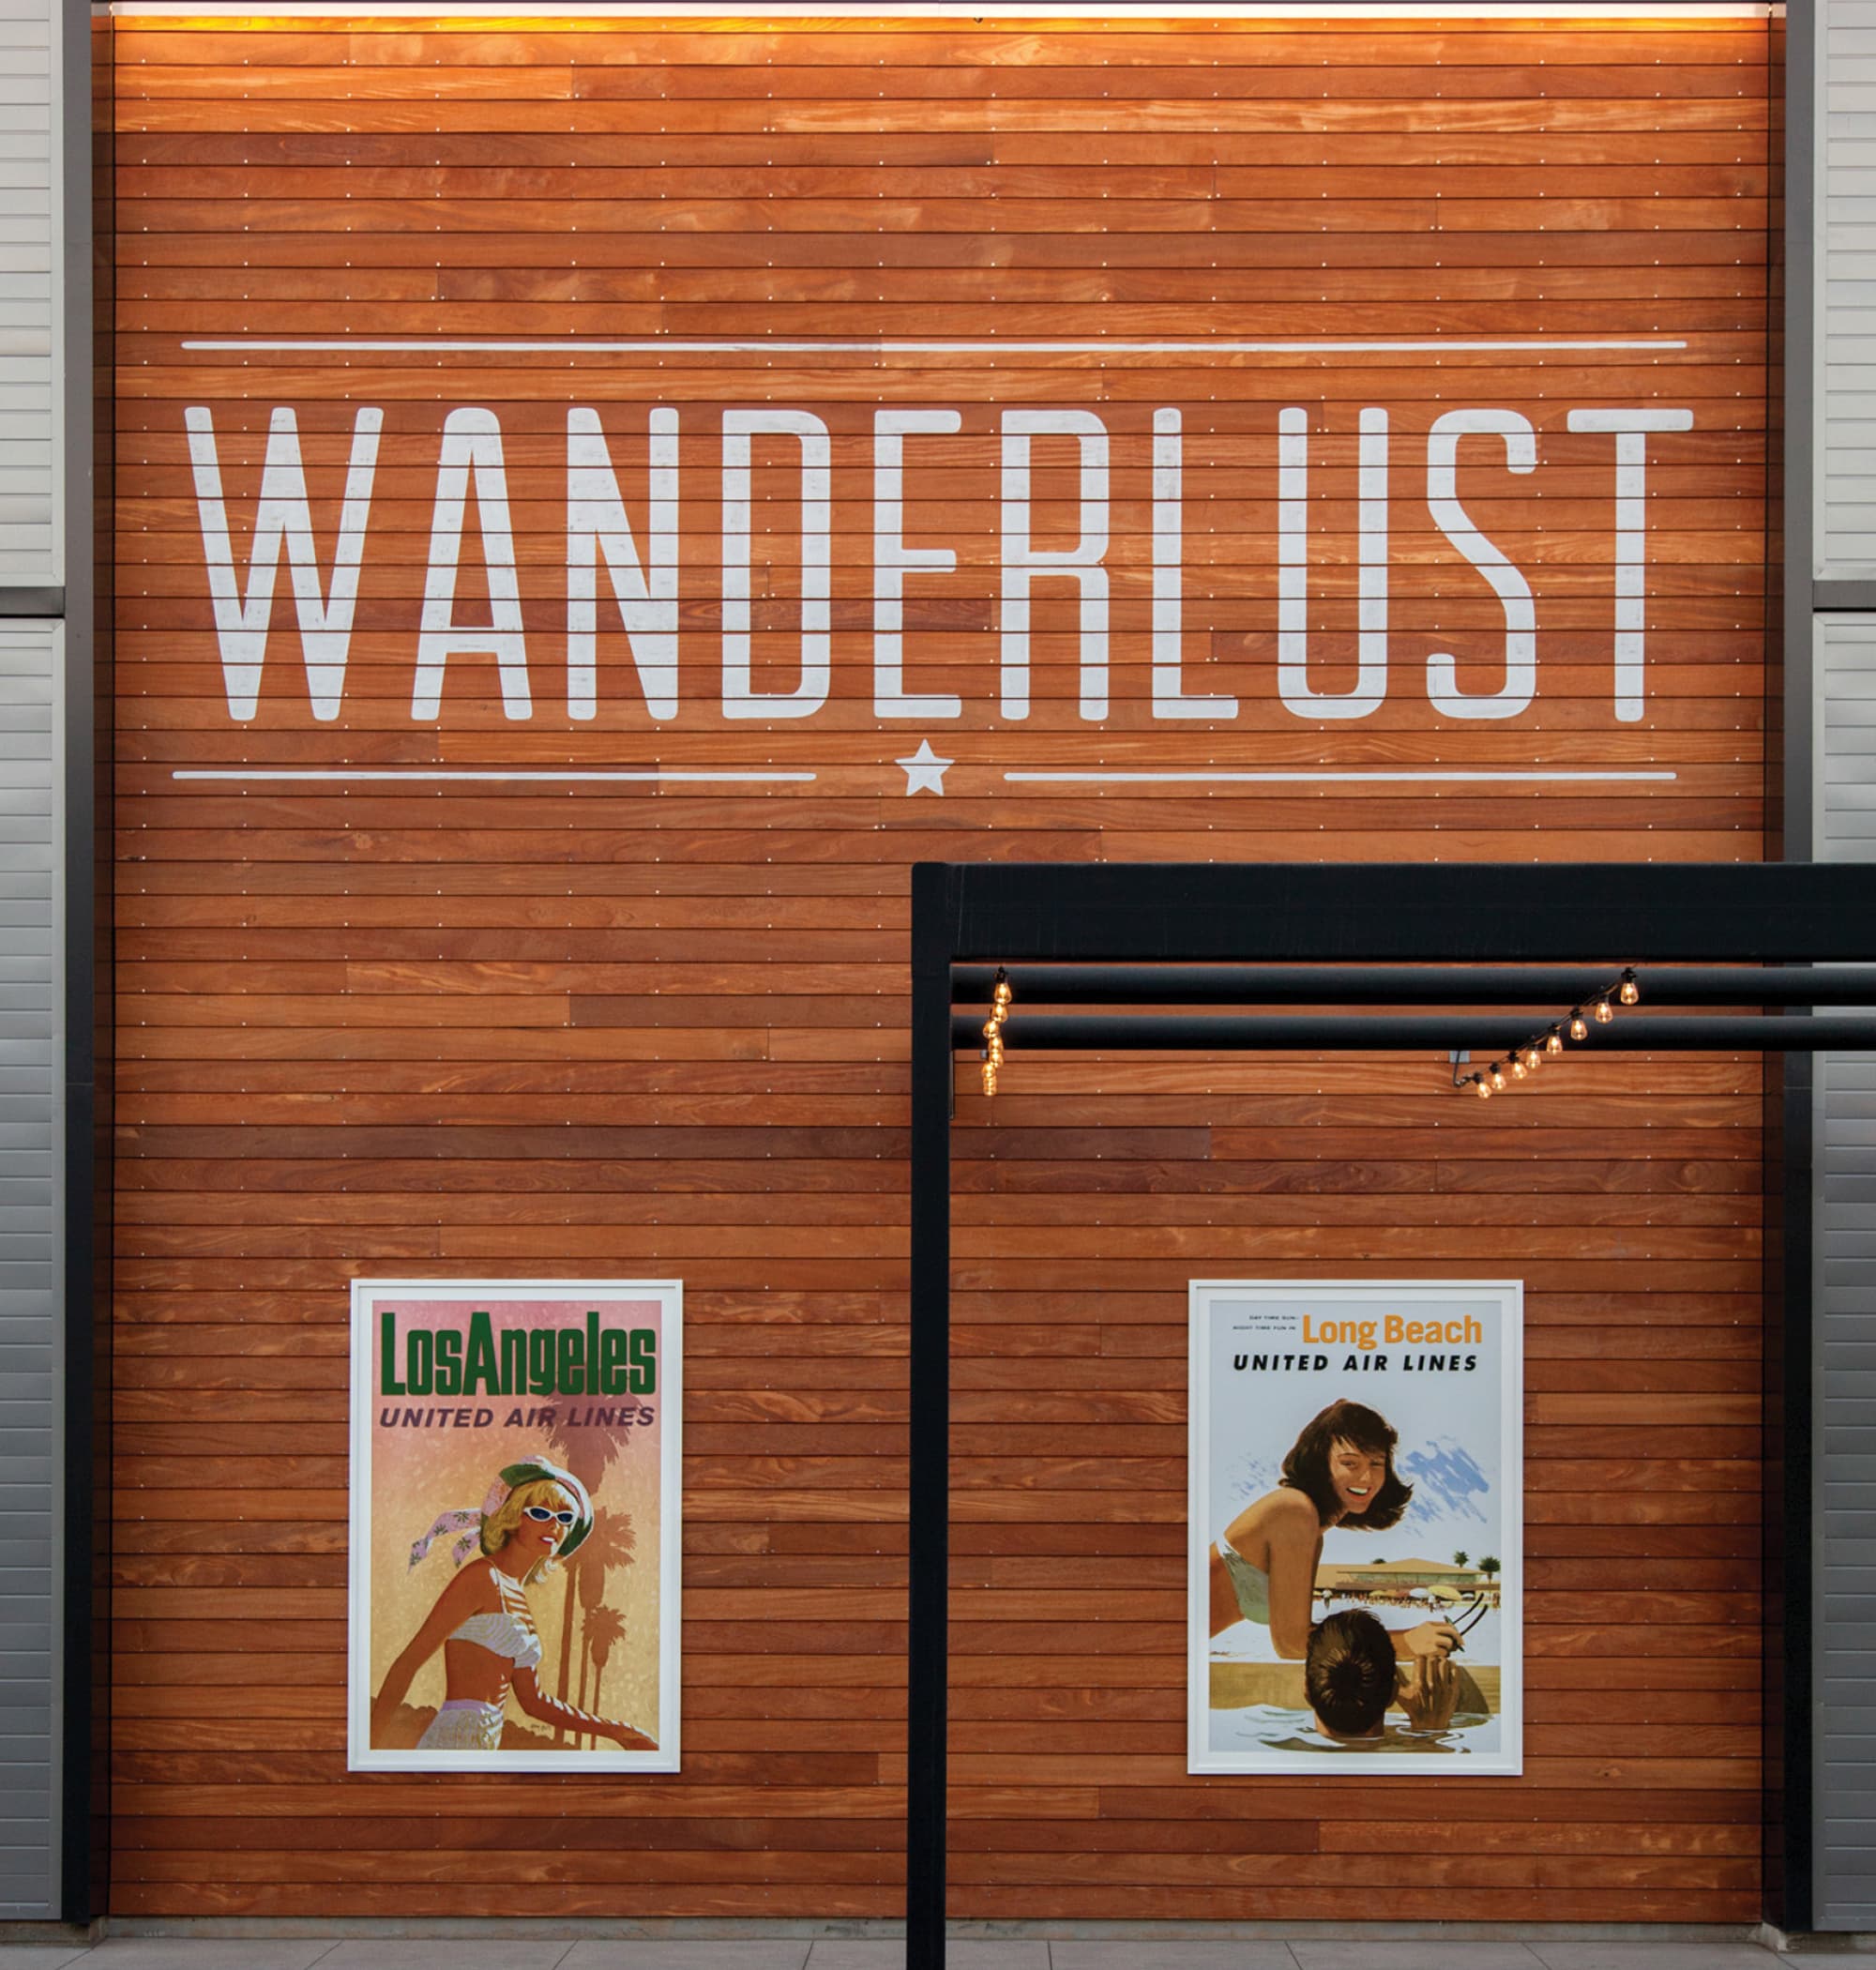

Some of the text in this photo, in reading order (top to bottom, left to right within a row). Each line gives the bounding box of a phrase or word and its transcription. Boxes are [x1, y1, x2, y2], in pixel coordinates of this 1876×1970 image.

[185, 406, 1695, 723] WANDERLUST
[1303, 1314, 1482, 1351] Long Beach
[1233, 1354, 1477, 1371] UNITED AIR LINES
[379, 1407, 655, 1428] UNITED AIR LINES
